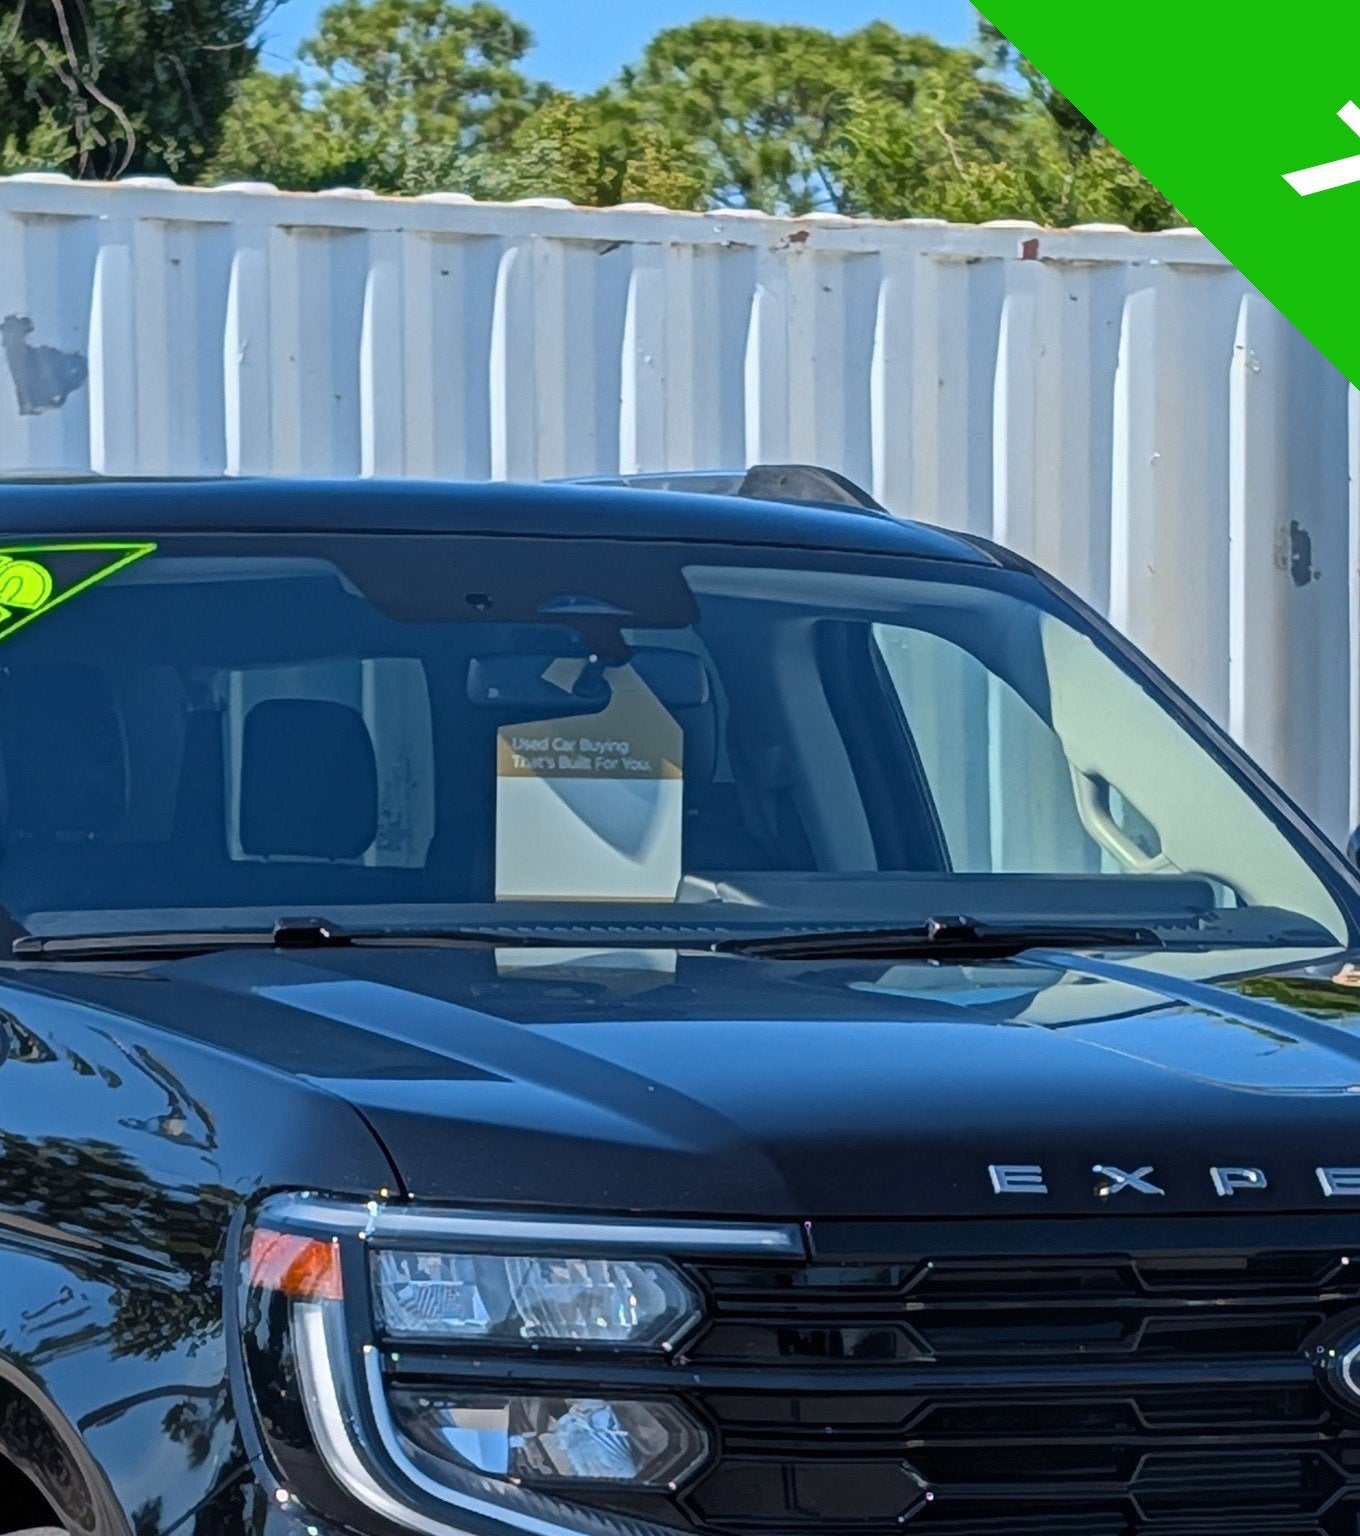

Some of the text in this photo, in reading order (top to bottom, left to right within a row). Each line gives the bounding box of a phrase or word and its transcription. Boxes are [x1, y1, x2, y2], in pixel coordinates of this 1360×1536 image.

[512, 737, 629, 755] Used Car Buying
[512, 754, 555, 769] That's
[558, 755, 591, 770] Built
[595, 756, 619, 770] For
